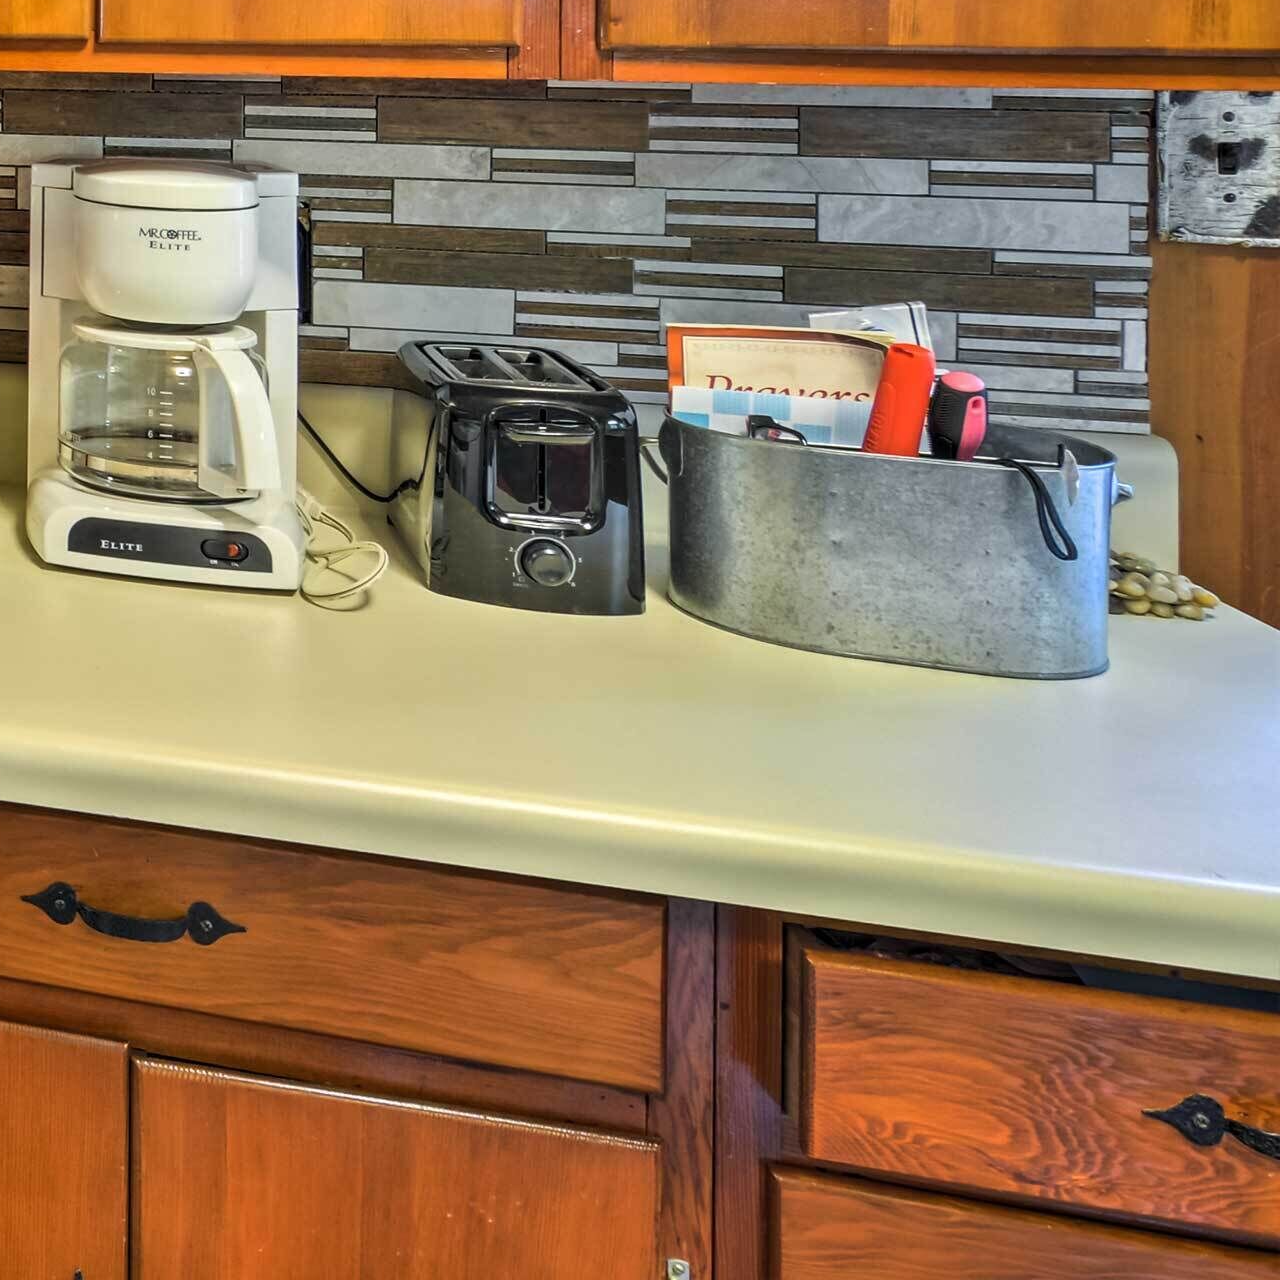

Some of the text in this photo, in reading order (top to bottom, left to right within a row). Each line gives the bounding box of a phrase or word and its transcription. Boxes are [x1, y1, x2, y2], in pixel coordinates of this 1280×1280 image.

[149, 241, 190, 251] ELITE
[147, 387, 156, 396] 10
[148, 430, 154, 438] 6
[100, 539, 143, 552] ELITE
